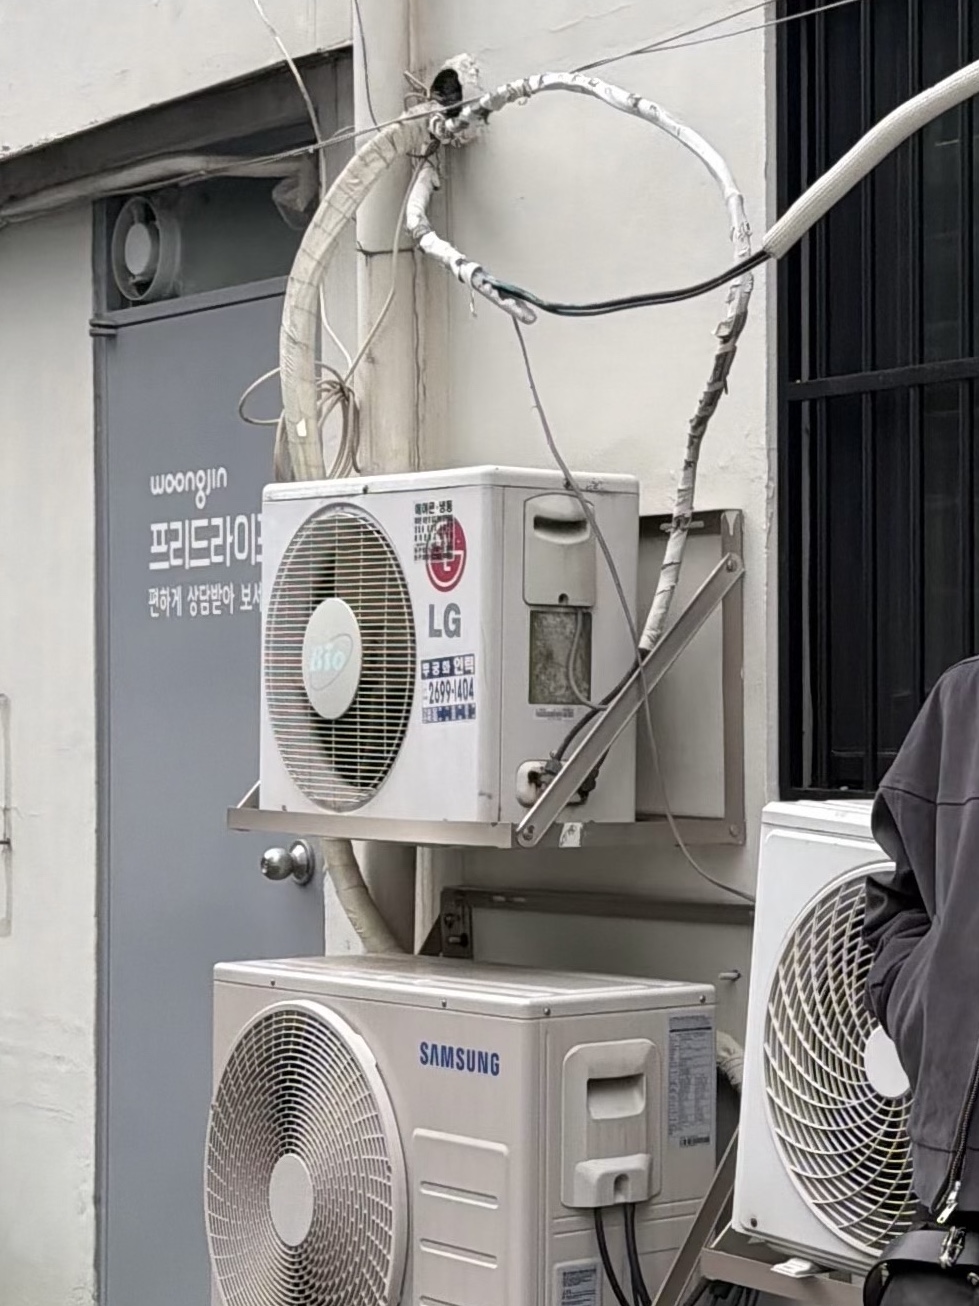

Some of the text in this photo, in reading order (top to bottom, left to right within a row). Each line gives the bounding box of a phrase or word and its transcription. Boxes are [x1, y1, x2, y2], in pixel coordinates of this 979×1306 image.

[150, 467, 228, 510] woongjin
[149, 513, 262, 570] 프리드라이
[148, 584, 183, 618] 편하게
[187, 581, 236, 617] 상담받아
[428, 602, 461, 639] LG
[420, 1041, 500, 1076] SAMSUNG
